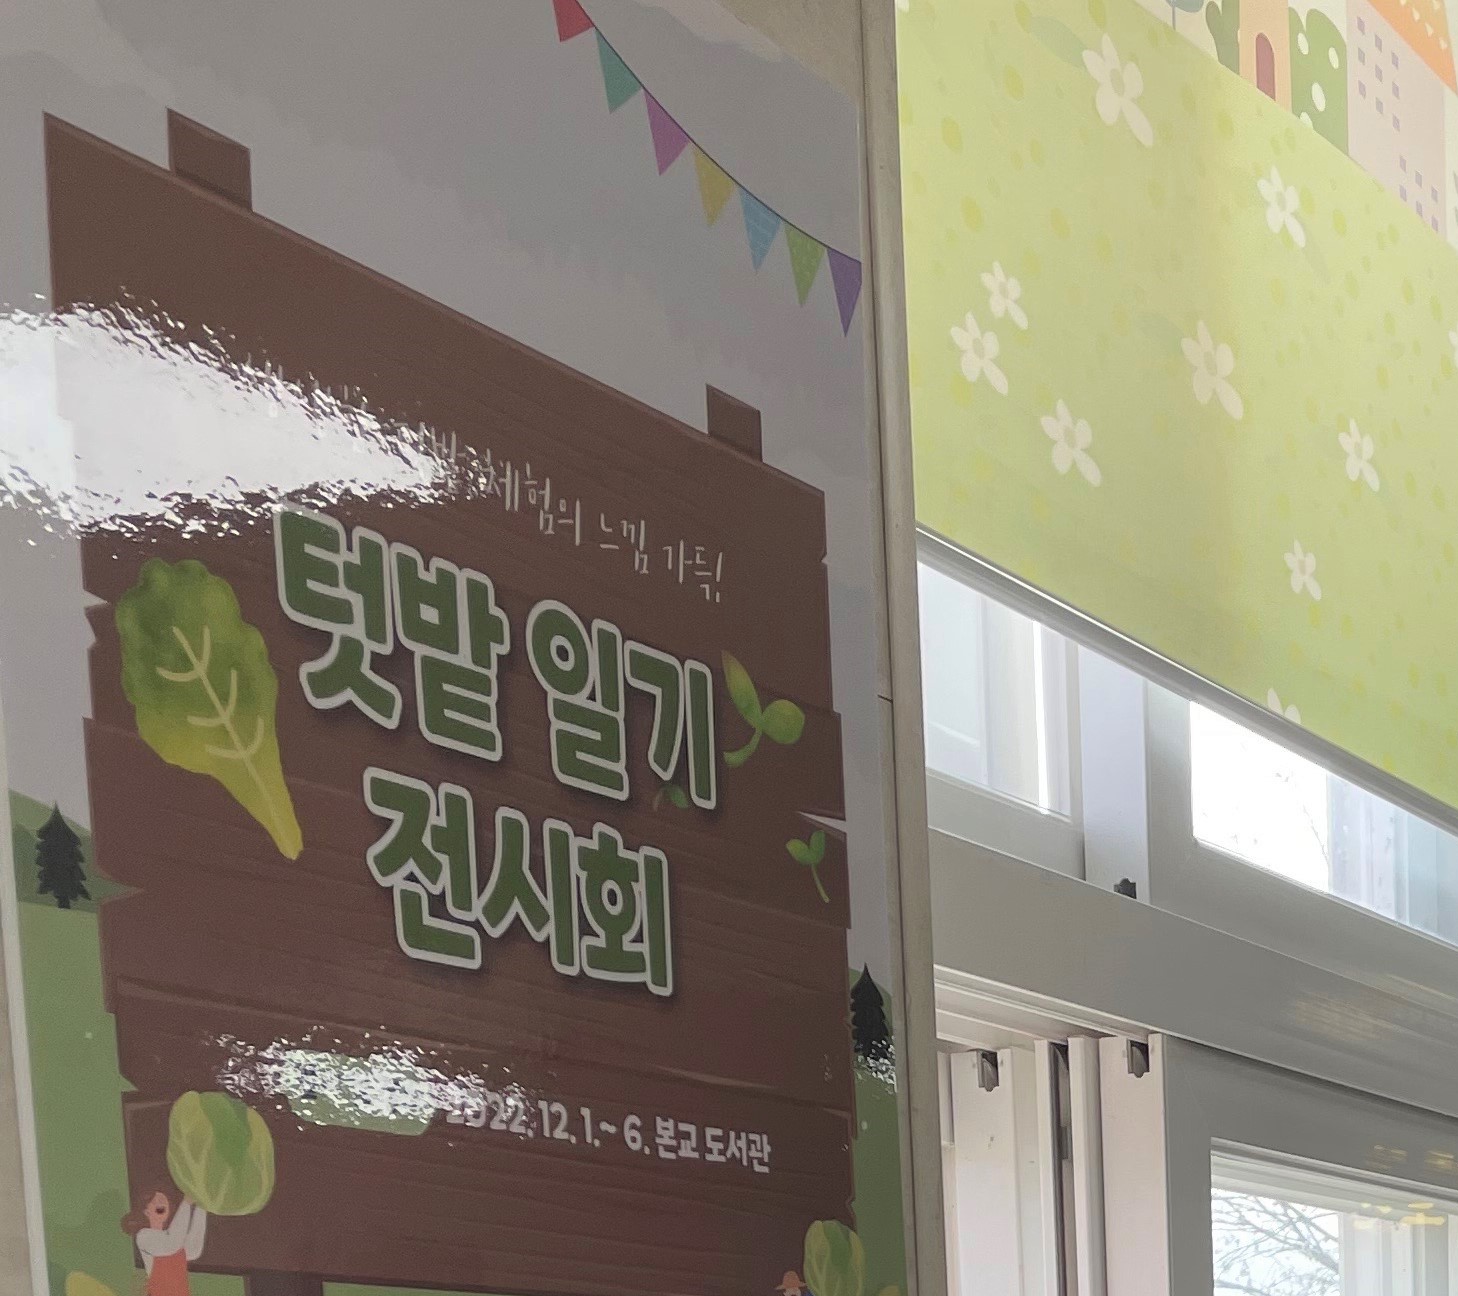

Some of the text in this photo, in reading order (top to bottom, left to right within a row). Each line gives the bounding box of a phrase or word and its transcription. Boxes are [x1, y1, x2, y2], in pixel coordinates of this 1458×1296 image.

[599, 512, 650, 575] 느낌
[662, 539, 724, 603] 가득!
[274, 506, 718, 810] 텃밭 일기
[363, 766, 674, 998] 전시회
[654, 1115, 700, 1160] 본교
[704, 1126, 772, 1174] 도서관
